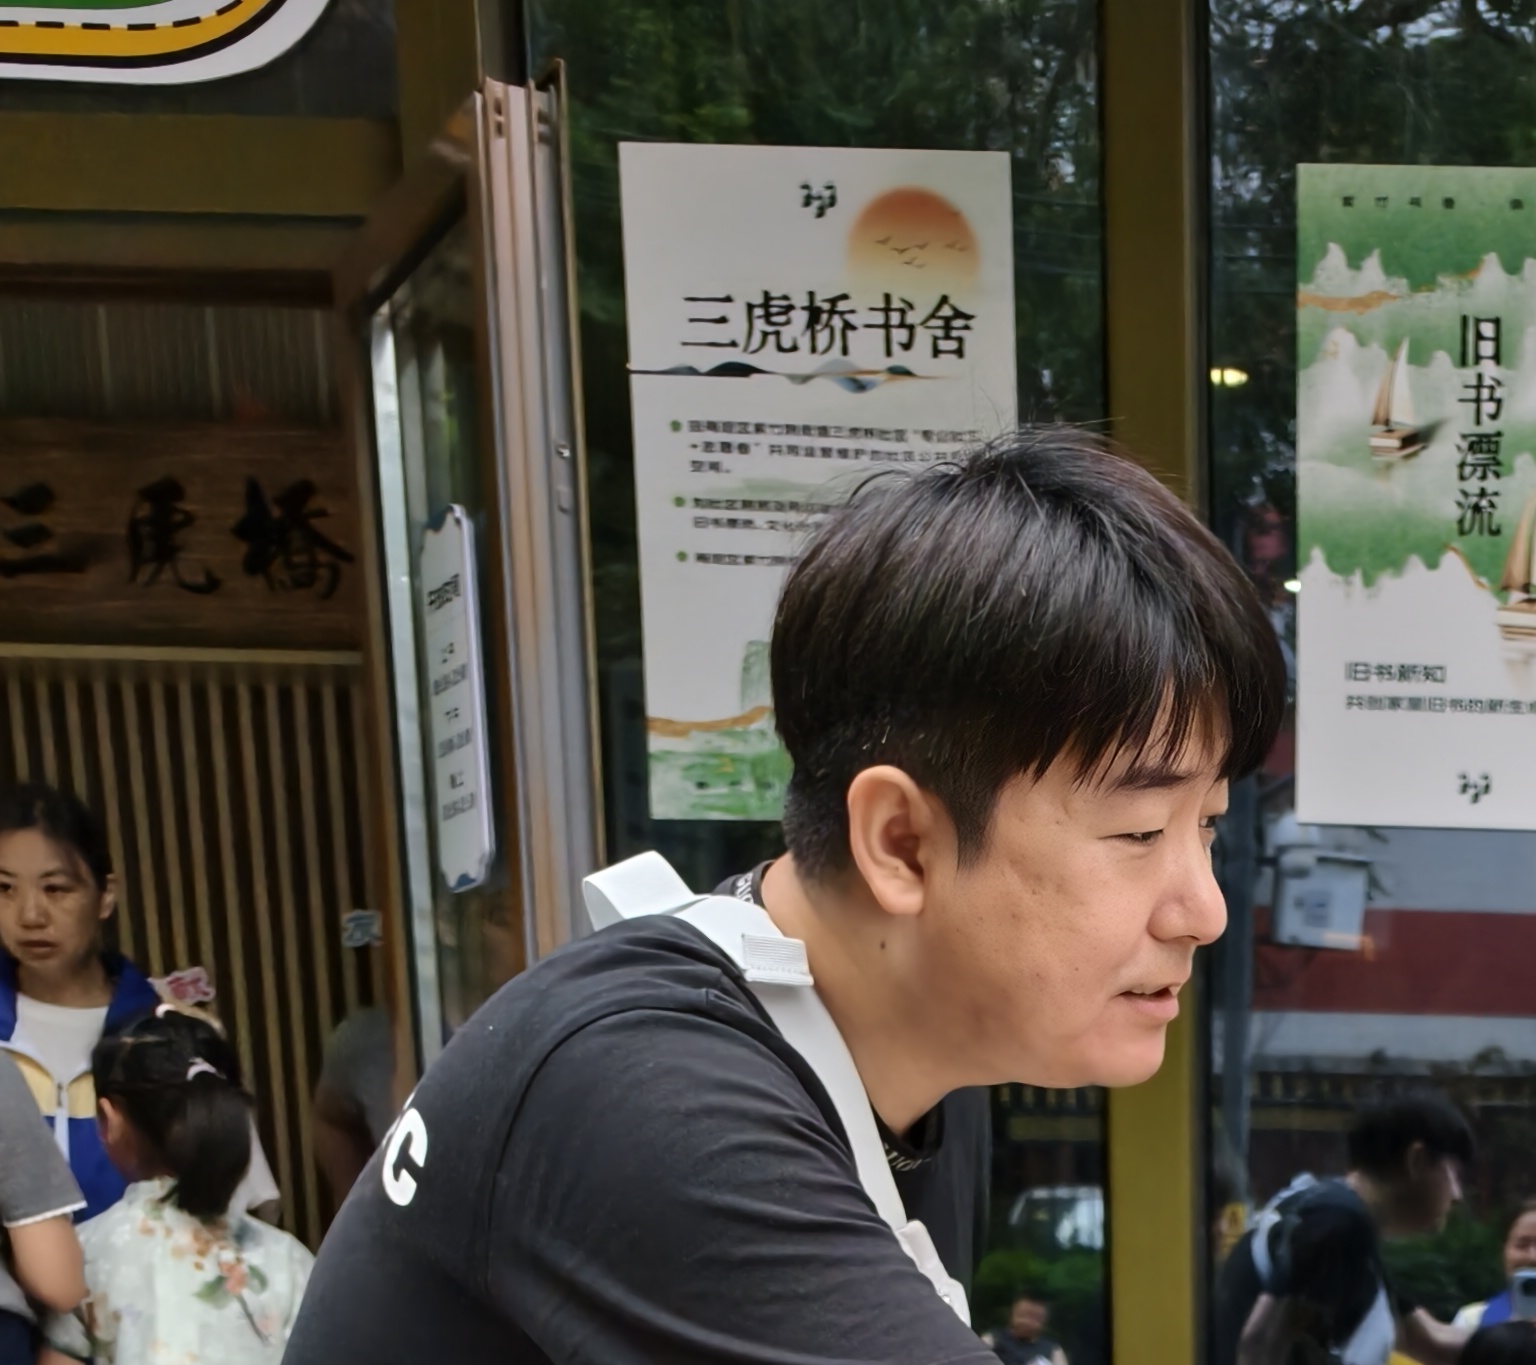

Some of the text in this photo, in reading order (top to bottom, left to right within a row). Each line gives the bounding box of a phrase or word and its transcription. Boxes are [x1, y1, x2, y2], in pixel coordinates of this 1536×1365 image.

[680, 289, 978, 359] 三虎桥书舍
[1456, 314, 1506, 537] 旧书漂流
